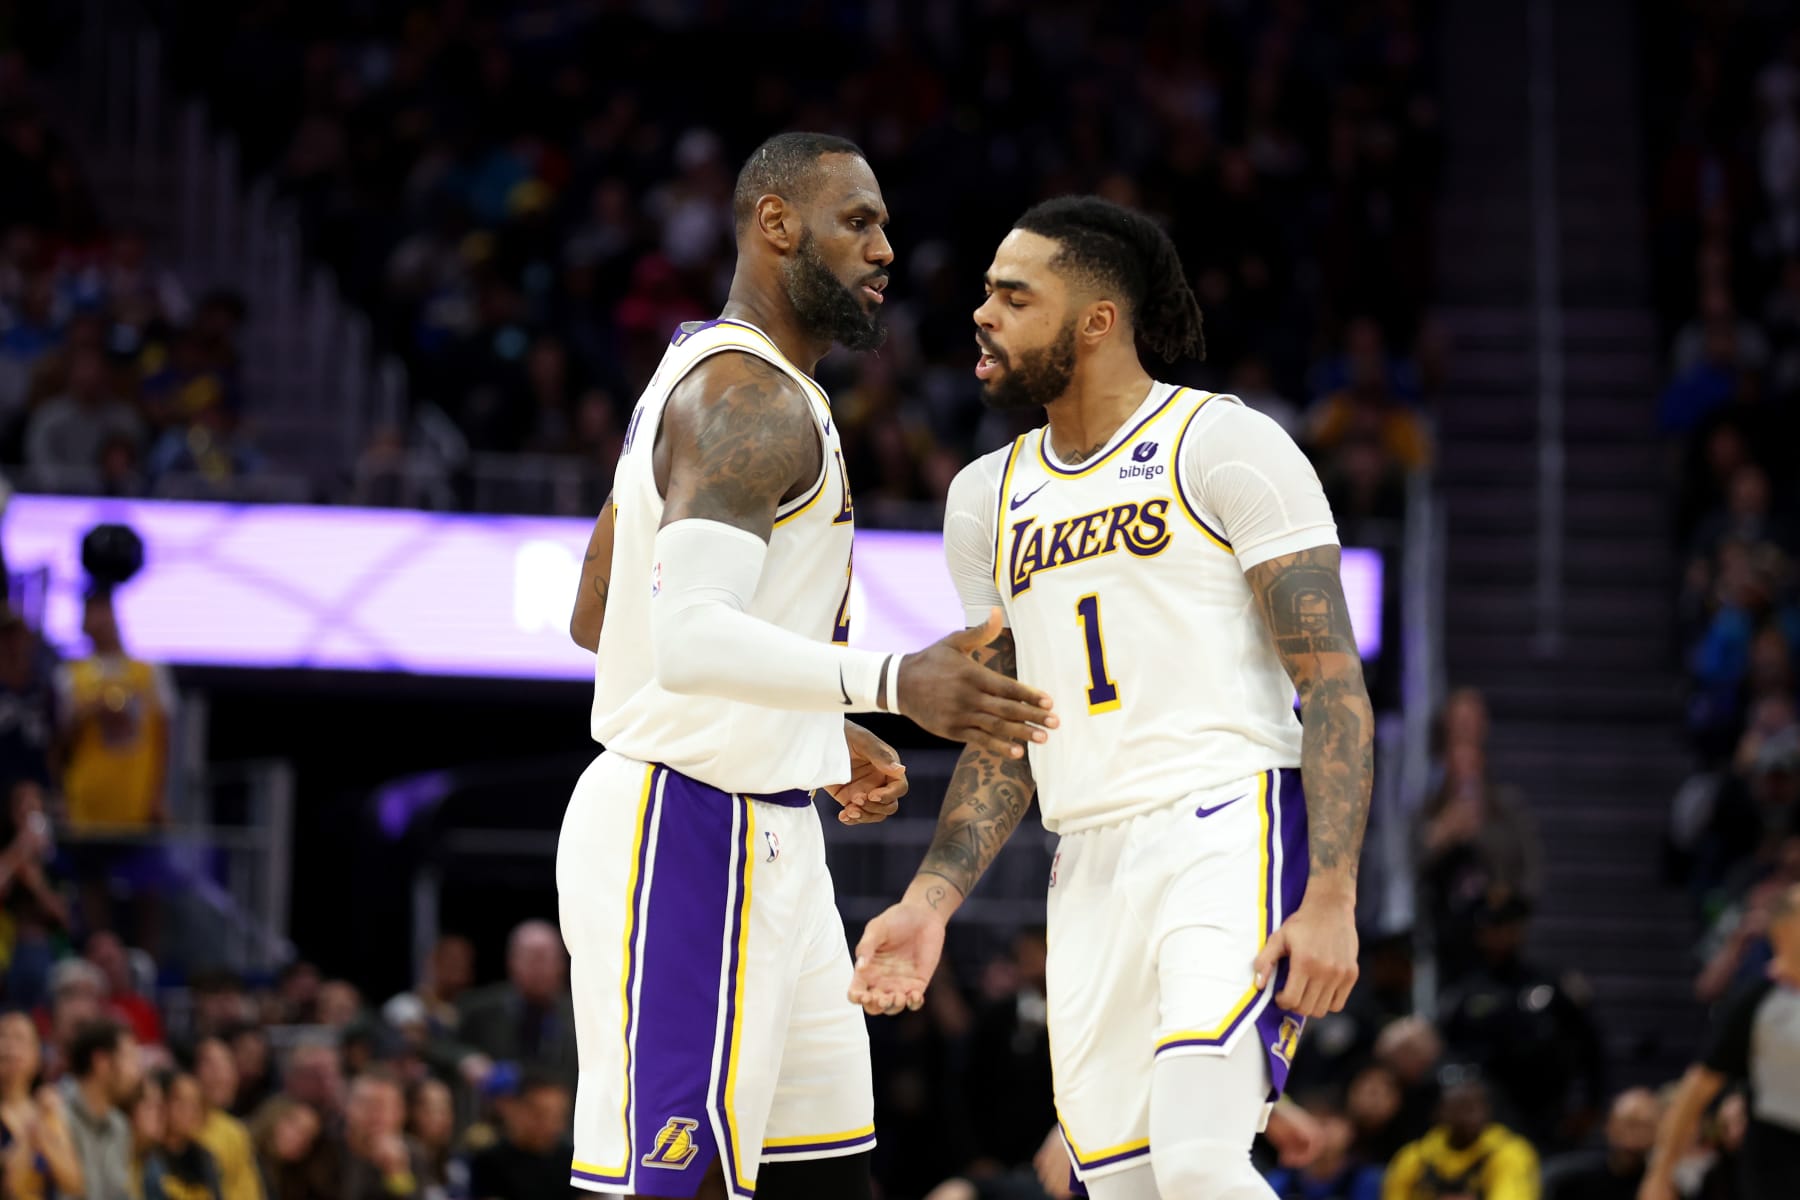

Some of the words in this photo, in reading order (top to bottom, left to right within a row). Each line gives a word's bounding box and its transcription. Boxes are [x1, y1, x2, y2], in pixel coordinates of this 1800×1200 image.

[1118, 463, 1165, 480] bibigo
[1010, 498, 1174, 600] LAKERS
[1076, 592, 1122, 715] 1
